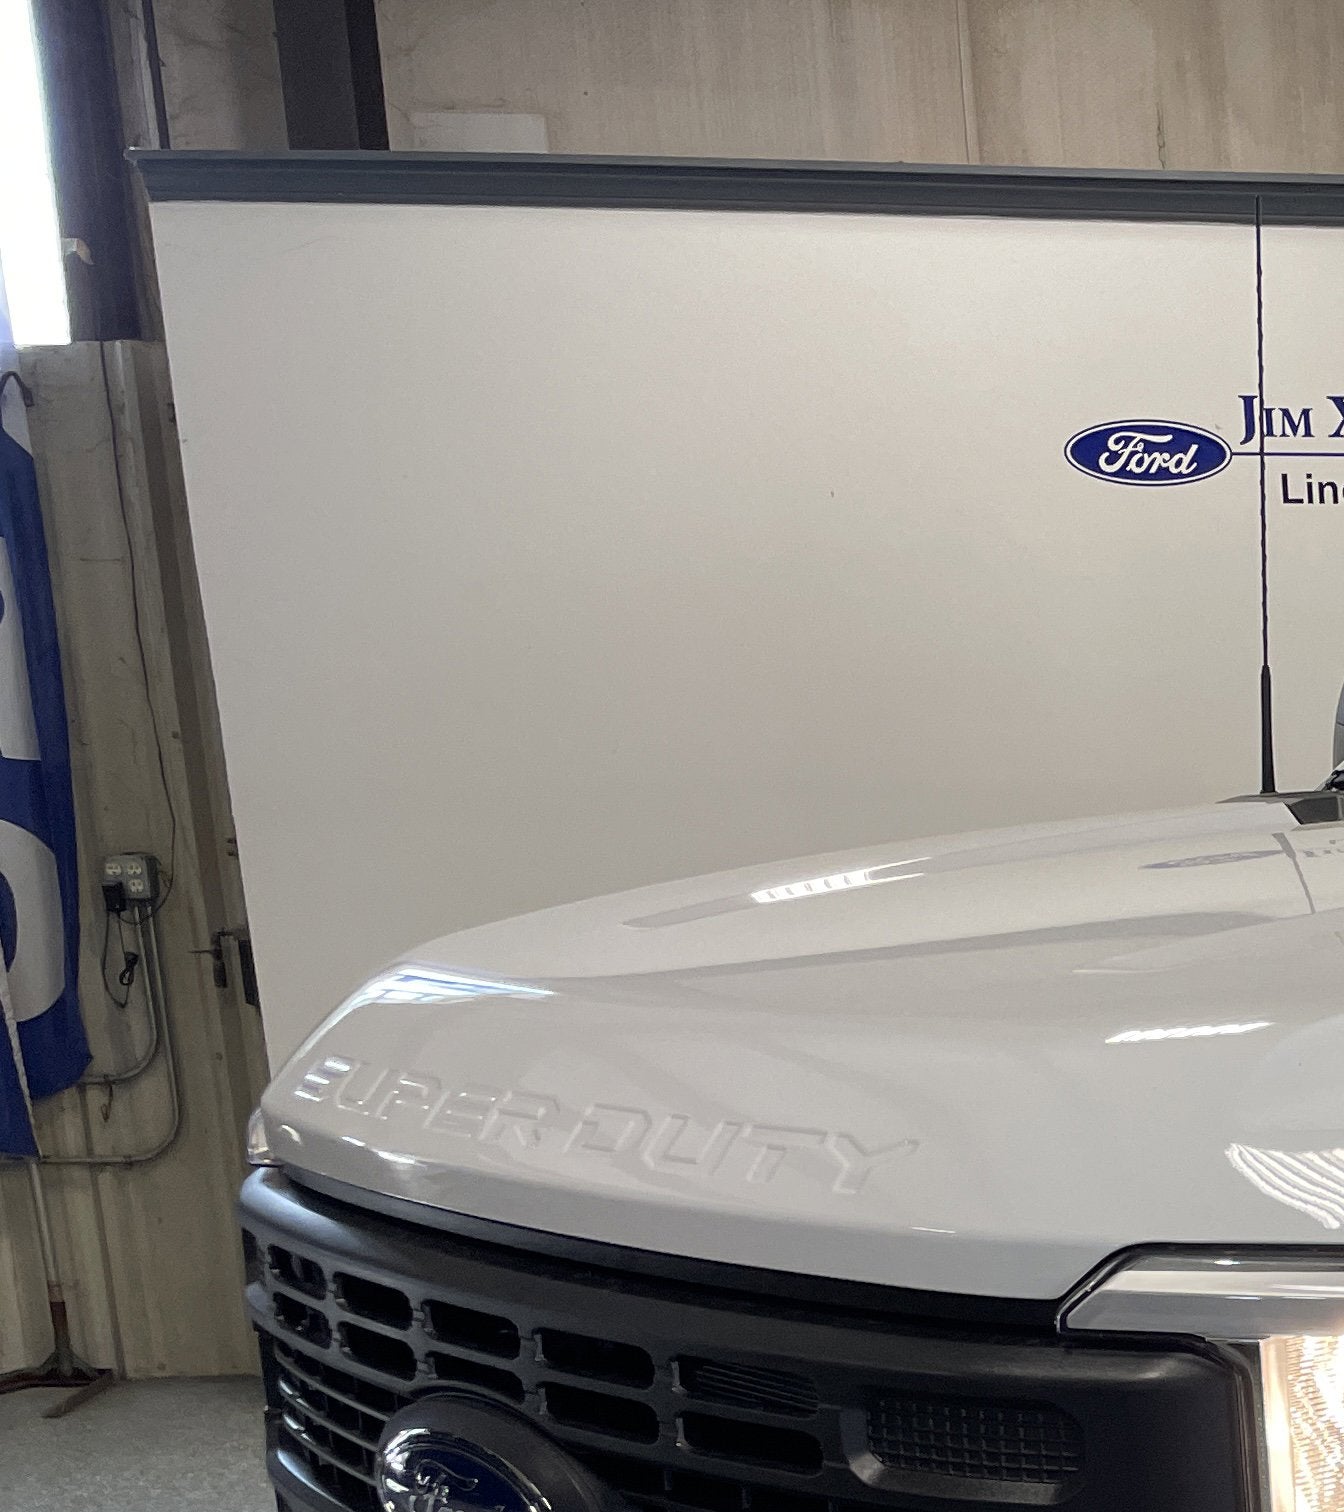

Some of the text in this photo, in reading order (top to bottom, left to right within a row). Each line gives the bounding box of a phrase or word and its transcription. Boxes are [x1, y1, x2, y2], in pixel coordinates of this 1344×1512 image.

[1098, 432, 1198, 475] Ford
[293, 1055, 918, 1195] SUPER DUTY
